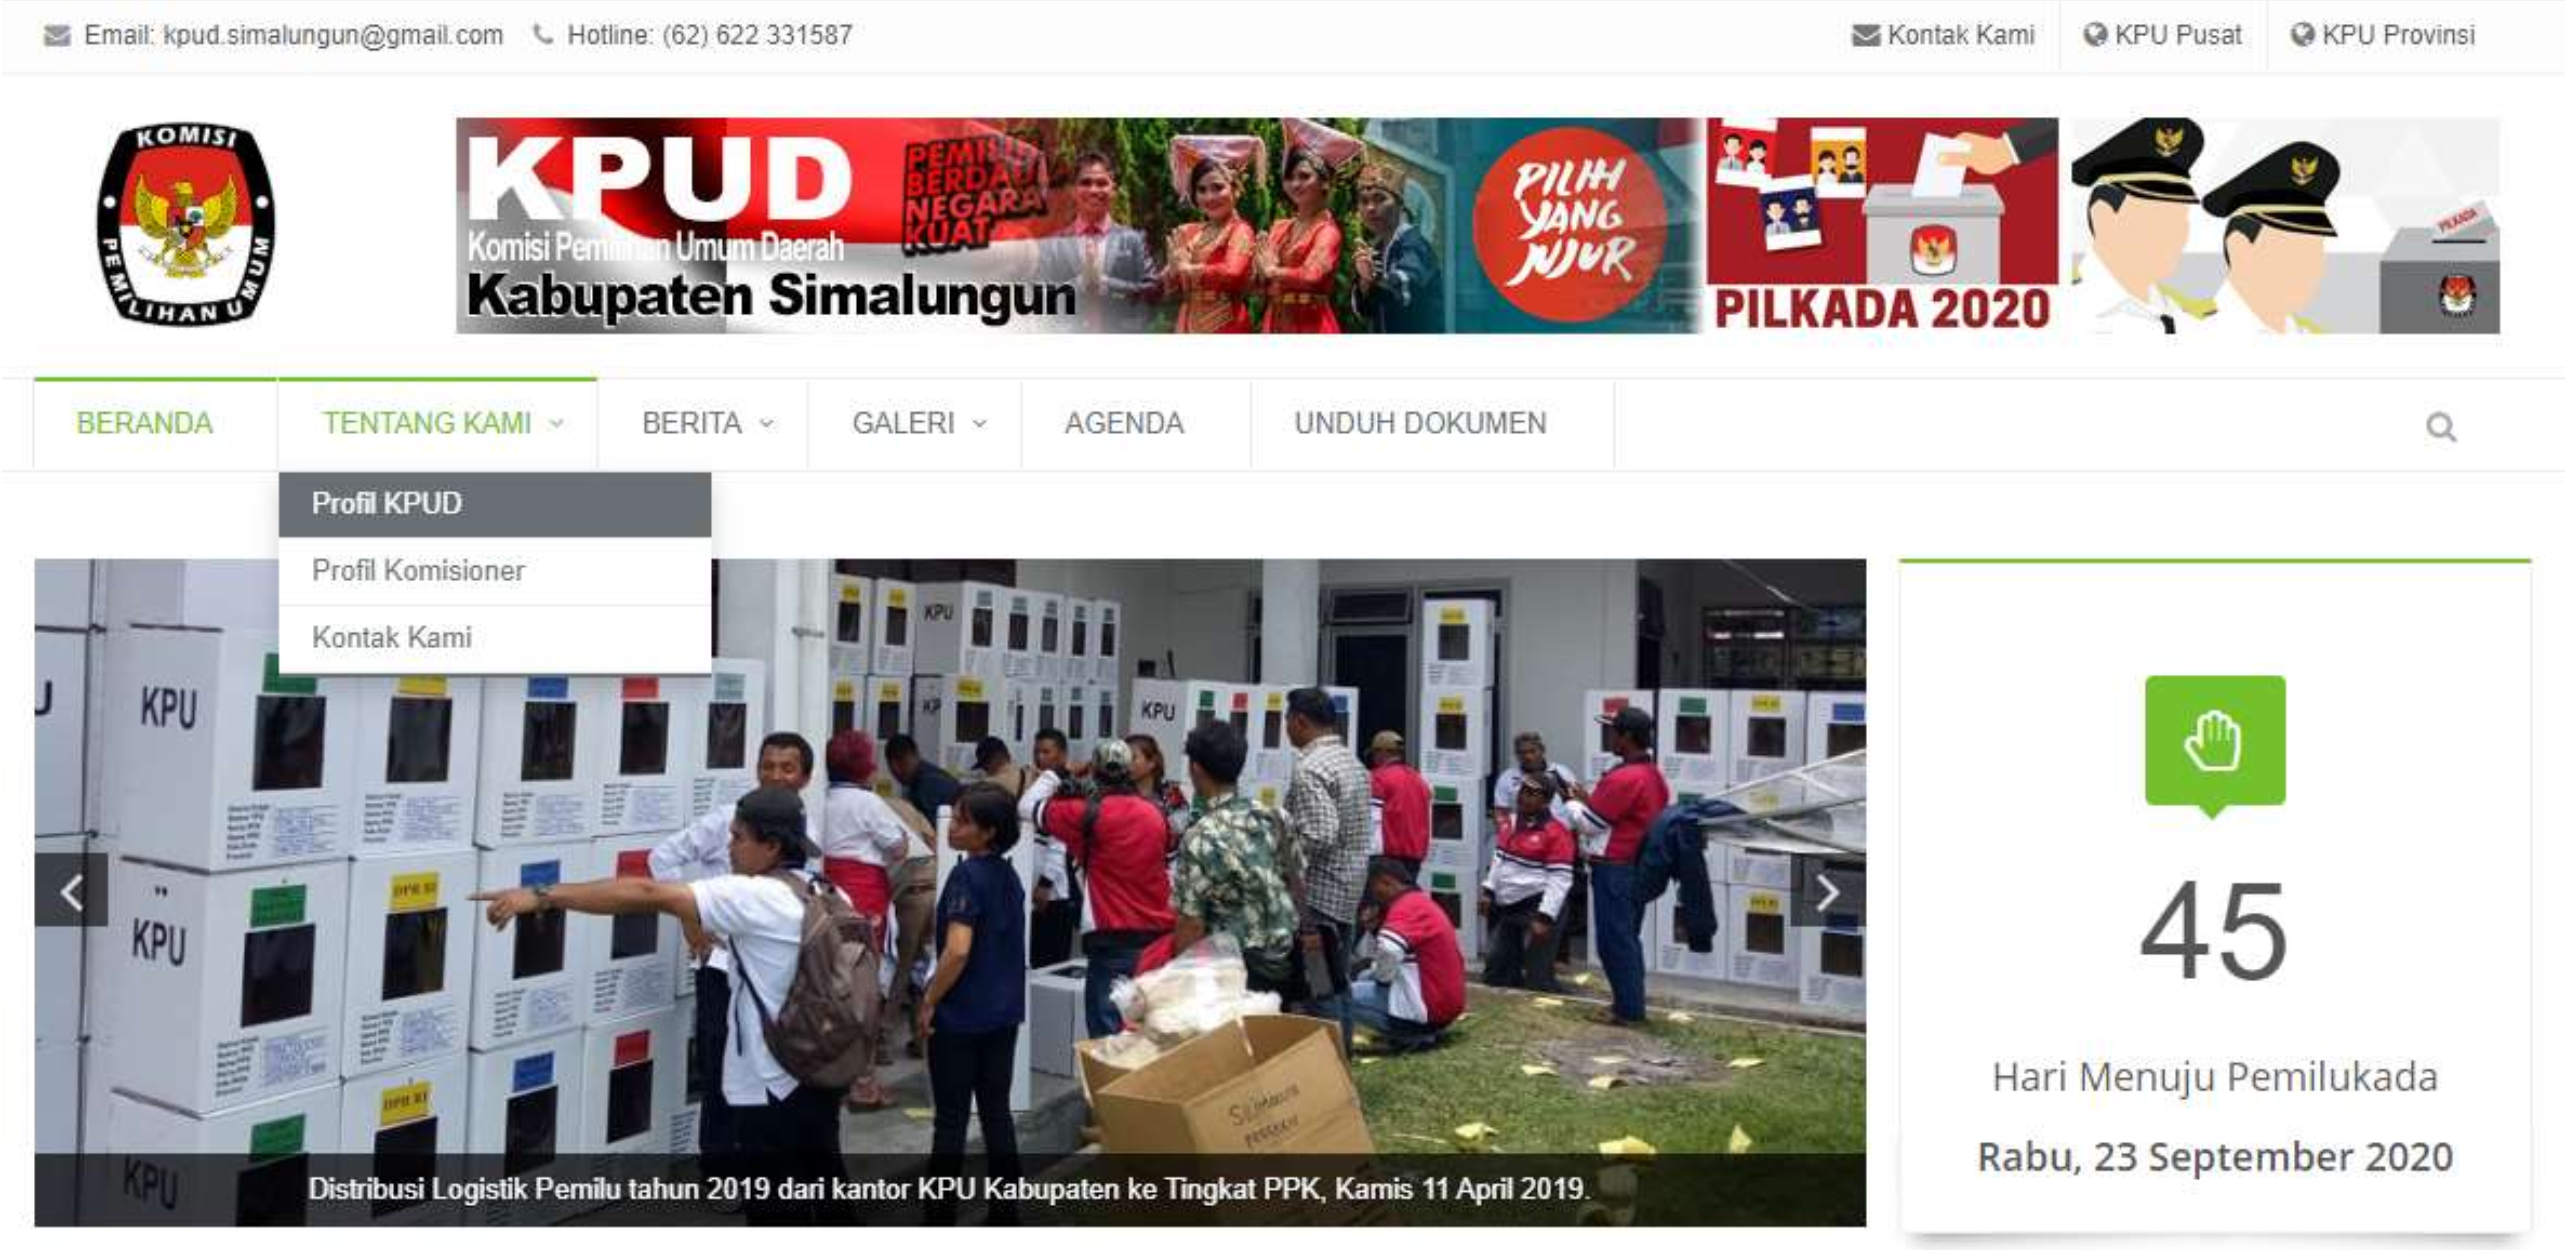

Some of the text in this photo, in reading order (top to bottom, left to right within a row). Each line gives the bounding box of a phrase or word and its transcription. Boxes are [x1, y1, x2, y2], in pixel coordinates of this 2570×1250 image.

[85, 23, 504, 52] Email: kpud.simalungun@gmail.com
[568, 23, 853, 51] Hotline: (62) 622 331587
[1888, 23, 2035, 46] Kontak Kami
[2116, 23, 2243, 46] KPU Pusat
[2323, 23, 2476, 46] KPU Provinsi
[136, 125, 237, 149] KOMISI
[468, 136, 853, 222] KPUD
[1513, 157, 1628, 201] PILIH
[905, 188, 1043, 224] NEGARA
[1517, 199, 1624, 240] YANG
[905, 216, 990, 246] KUAT
[467, 229, 551, 262] Komisi
[676, 229, 755, 262] Umum
[761, 229, 845, 262] Daerah
[102, 237, 217, 323] PEMILIHAN
[226, 236, 271, 317] UMUM
[468, 272, 1076, 327] Kabupaten Simalungun
[1715, 288, 2051, 329] PILKADA 2020
[75, 410, 214, 435] BERANDA
[323, 410, 531, 435] TENTANG KAMI
[643, 410, 743, 435] BERITA
[853, 410, 955, 435] GALERI
[1064, 410, 1185, 435] AGENDA
[1295, 410, 1547, 435] UNDUH DOKUMEN
[312, 490, 463, 515] Profil KPUD
[313, 557, 527, 582] Profil Komisioner
[925, 603, 954, 621] KPU
[312, 625, 472, 649] Kontak Kami
[140, 684, 197, 730] KPU
[923, 698, 942, 714] KP
[1141, 699, 1175, 722] KPU
[131, 917, 187, 967] KPU
[2140, 880, 2287, 982] 45
[1994, 1059, 2438, 1101] Hari Menuju Pemilukada
[1978, 1139, 2454, 1181] Rabu, 23 September 2020
[122, 1156, 178, 1210] KPU
